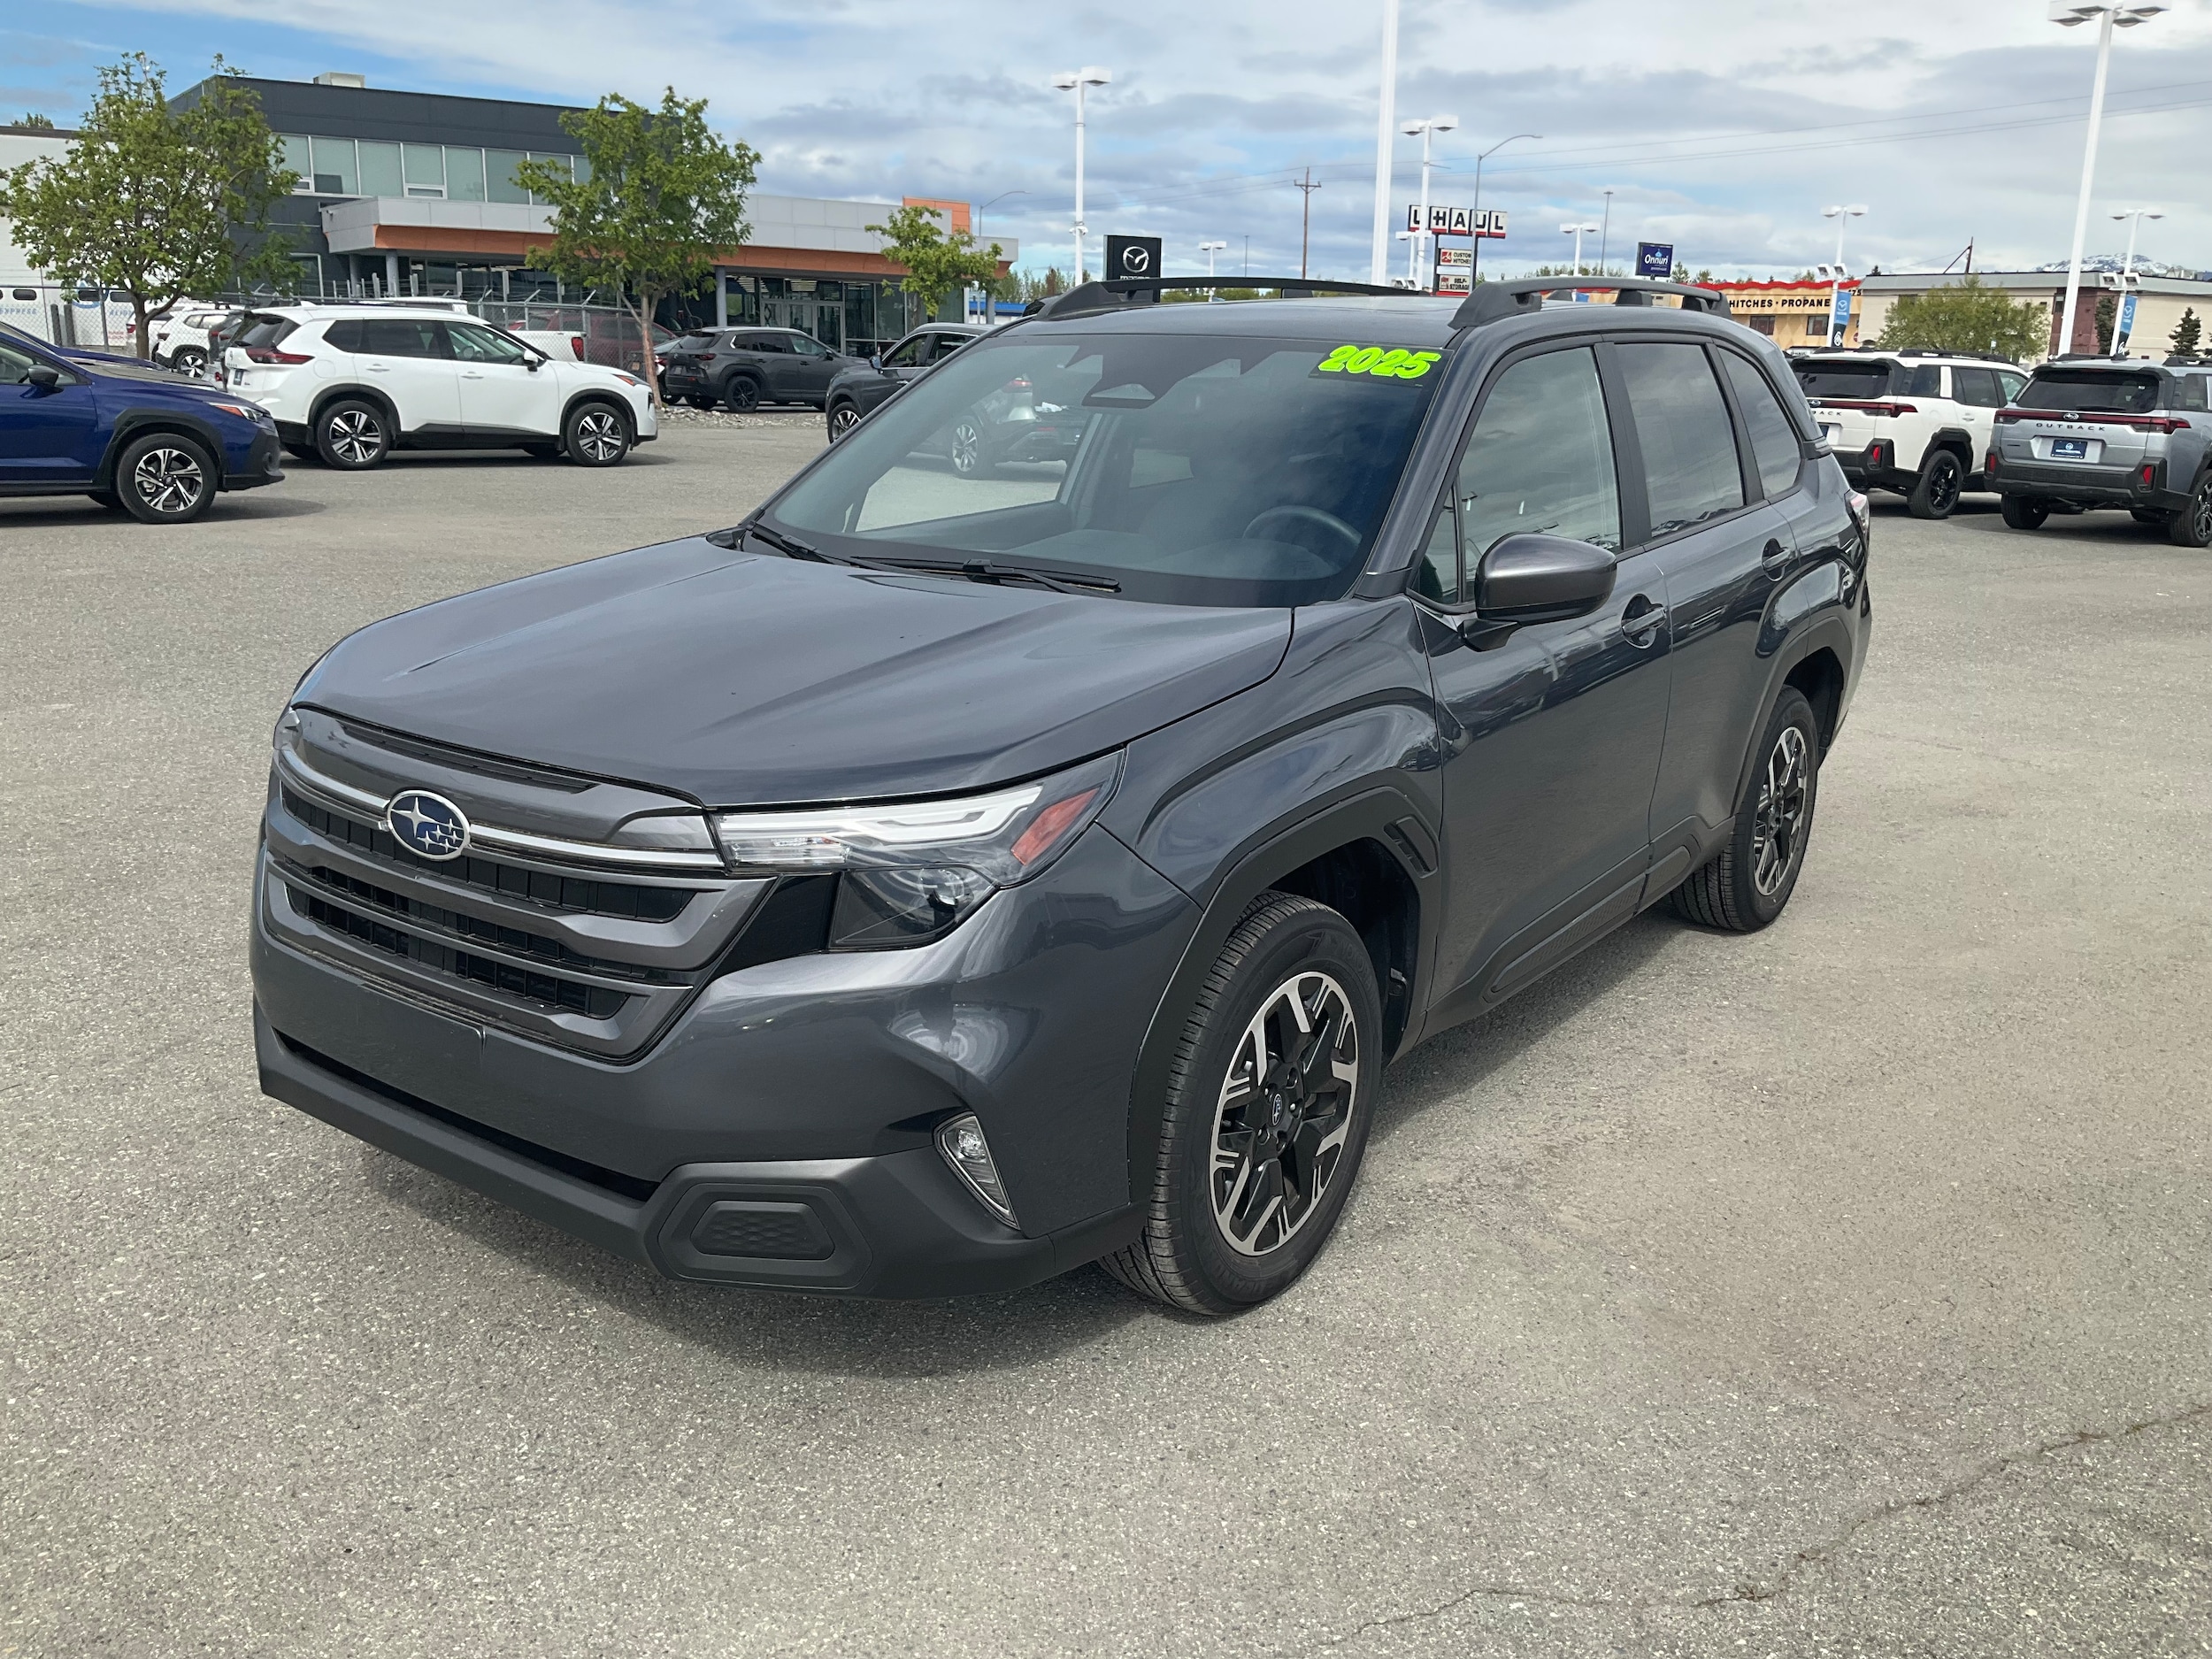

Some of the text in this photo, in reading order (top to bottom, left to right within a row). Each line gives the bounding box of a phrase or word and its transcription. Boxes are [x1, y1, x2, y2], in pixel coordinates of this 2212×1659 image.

[1644, 254, 1669, 265] Onnuri
[1729, 298, 1831, 308] HITCHES PROPANE
[1317, 345, 1442, 379] 2025
